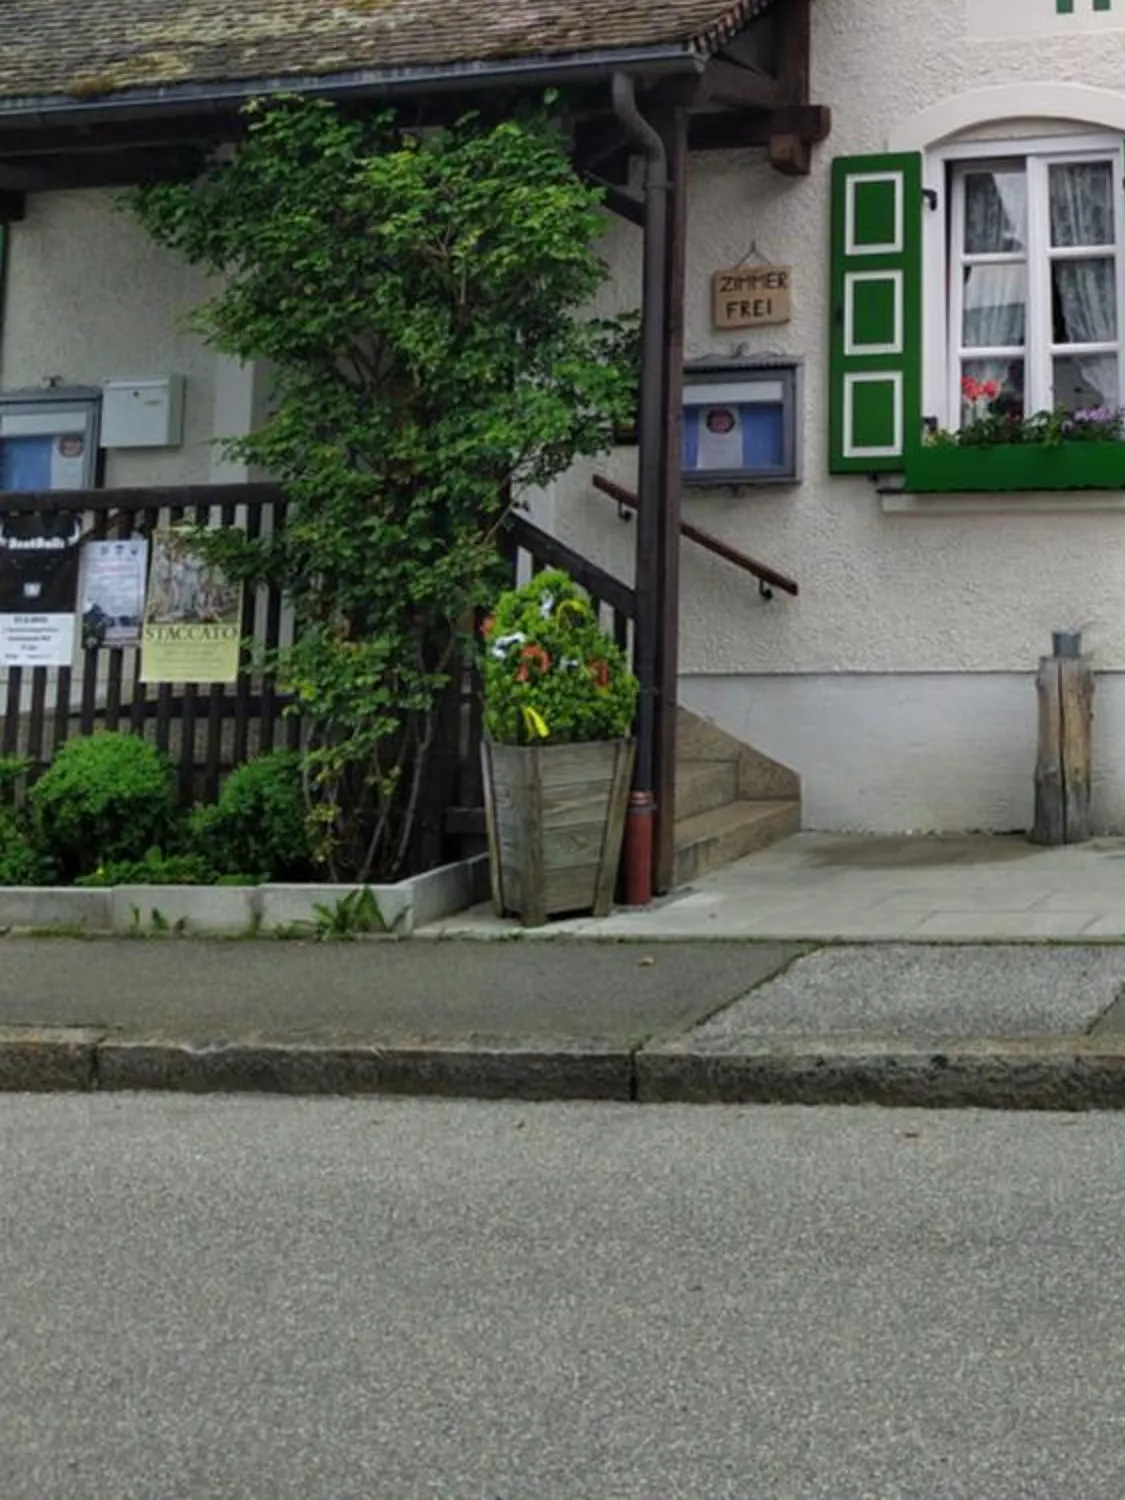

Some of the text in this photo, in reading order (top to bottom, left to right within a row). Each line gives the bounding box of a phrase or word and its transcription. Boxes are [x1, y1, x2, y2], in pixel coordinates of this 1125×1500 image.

[719, 272, 788, 293] ZIMMER
[726, 297, 772, 321] FREI
[145, 626, 238, 641] STACCATO
